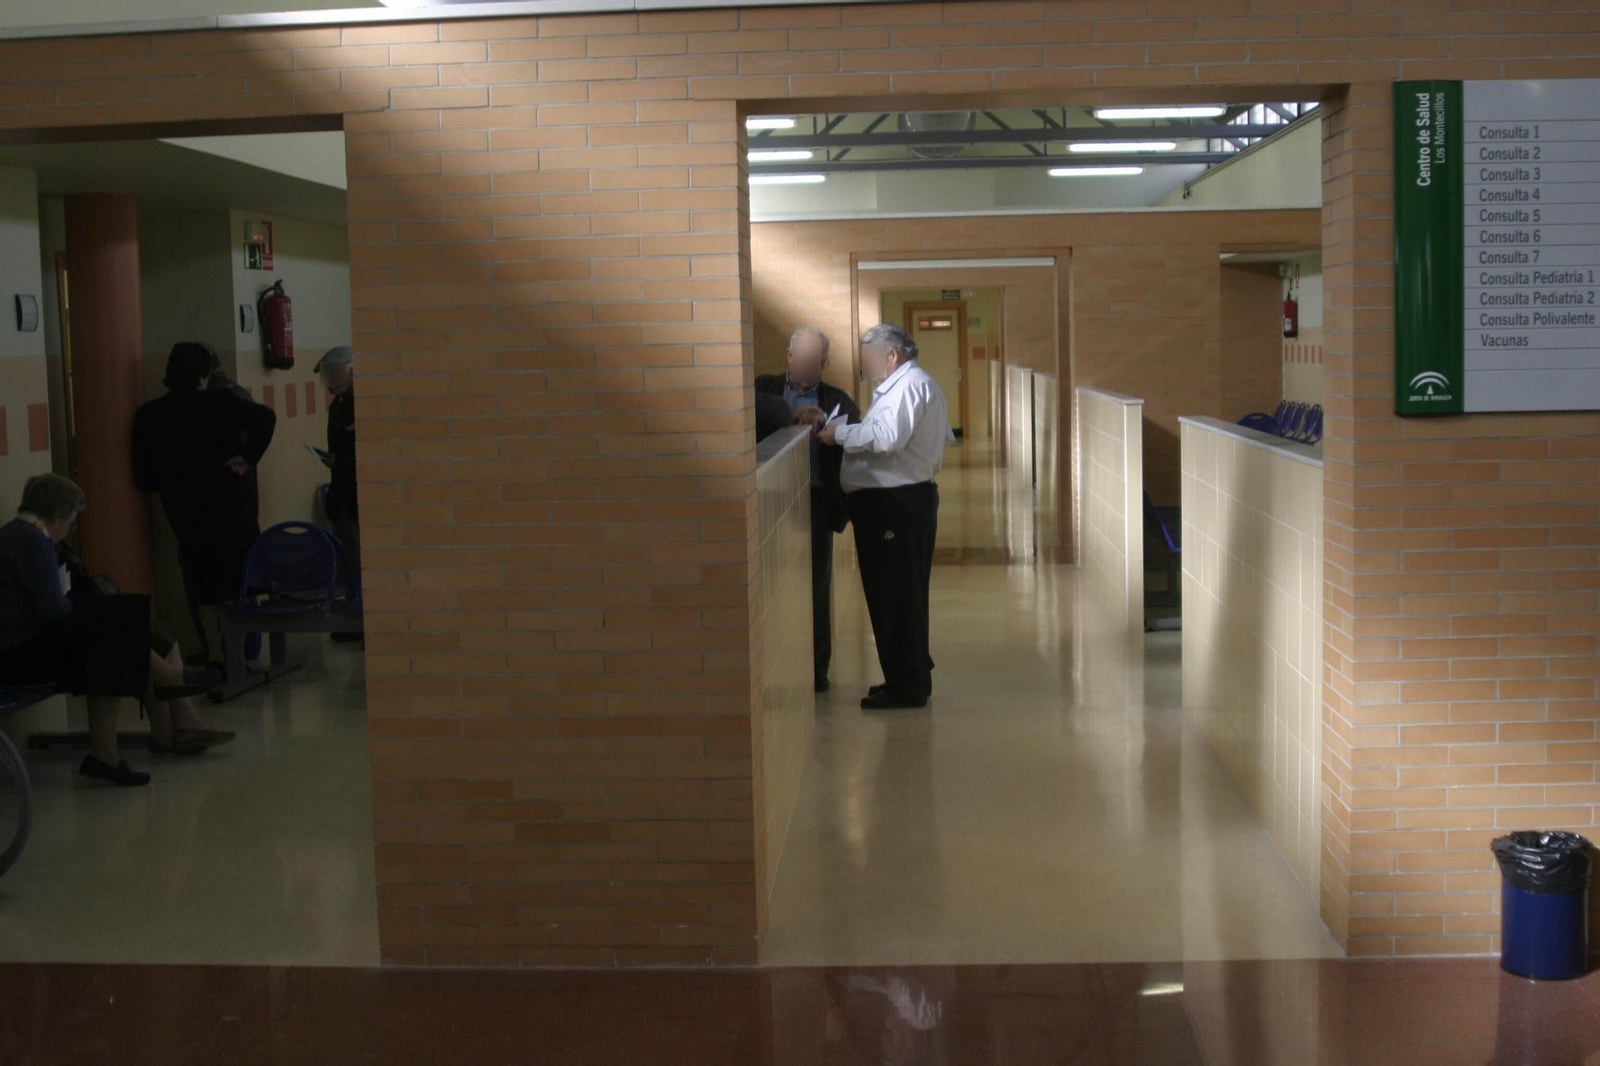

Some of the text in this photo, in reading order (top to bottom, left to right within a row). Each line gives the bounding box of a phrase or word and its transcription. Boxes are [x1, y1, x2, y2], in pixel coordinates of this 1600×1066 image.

[1434, 92, 1445, 164] Los Montecillos
[1480, 126, 1540, 139] Consulta 1
[1416, 92, 1431, 186] Centro de Salud
[1480, 146, 1540, 160] Consulta 2
[1480, 167, 1540, 181] Consulta 3
[1480, 188, 1540, 202] Consulta 4
[1480, 209, 1540, 222] Consulta 5
[1480, 230, 1540, 243] Consulta 6
[1480, 250, 1540, 264] Consulta 7
[1480, 270, 1594, 285] Consulta Pediatría 1
[1480, 290, 1594, 306] Consulta Pediatría 2
[1480, 312, 1595, 326] Consulta Polivalente
[1480, 334, 1529, 347] Vacunas
